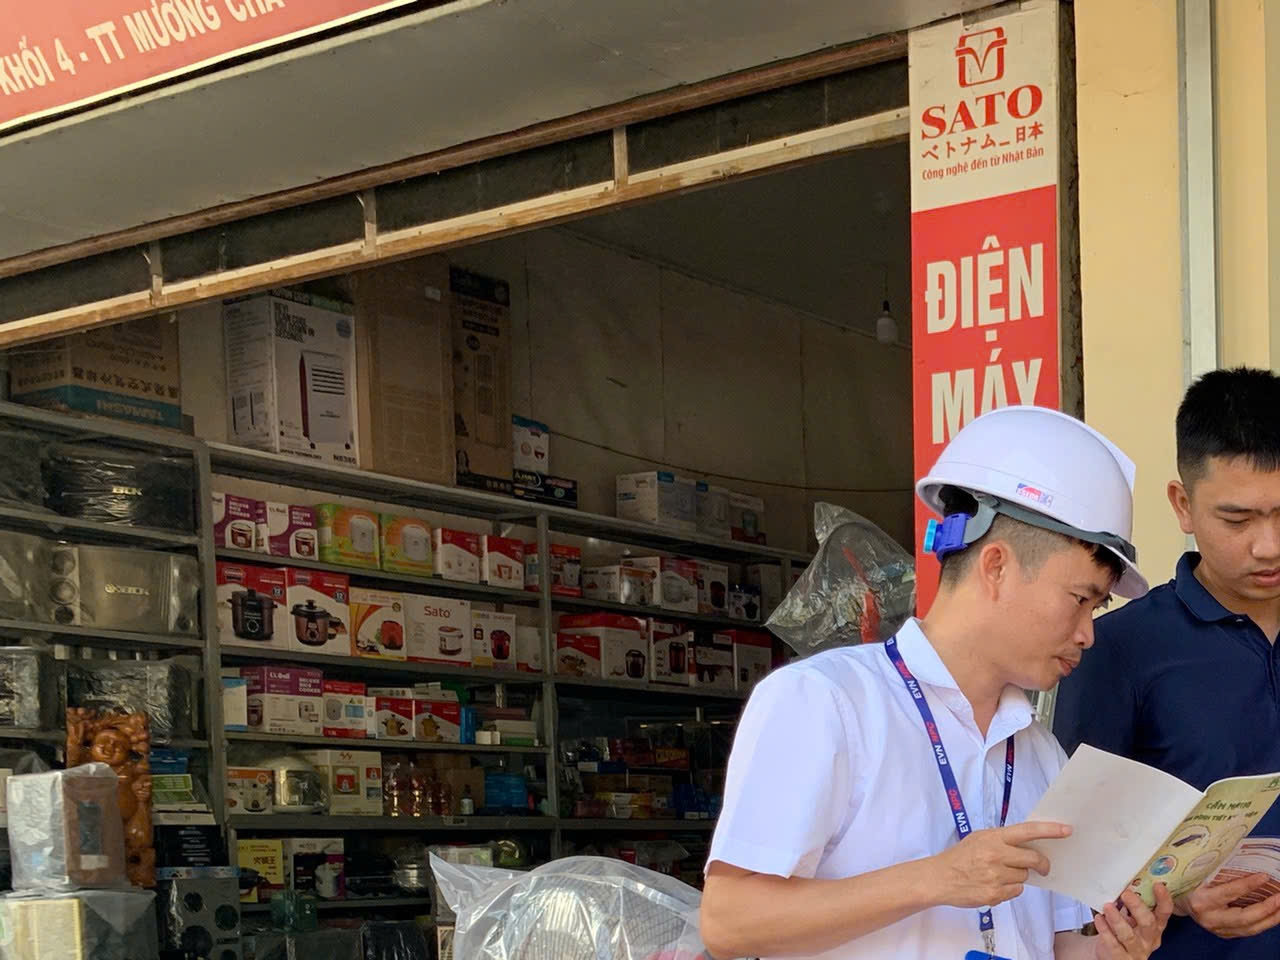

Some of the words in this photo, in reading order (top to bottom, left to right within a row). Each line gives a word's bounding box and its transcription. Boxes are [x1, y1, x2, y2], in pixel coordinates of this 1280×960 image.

[55, 38, 77, 75] 4
[84, 20, 125, 64] TT
[921, 84, 1043, 141] SATO
[922, 168, 944, 181] Công
[946, 161, 969, 176] nghệ
[971, 154, 988, 170] đến
[989, 152, 1001, 167] từ
[1002, 149, 1024, 164] Nhật
[1026, 145, 1045, 159] Bản
[925, 235, 1044, 343] ĐIỆN
[424, 606, 451, 618] Sato
[907, 680, 922, 700] EVN
[934, 745, 947, 766] EVN
[956, 812, 969, 833] EVN
